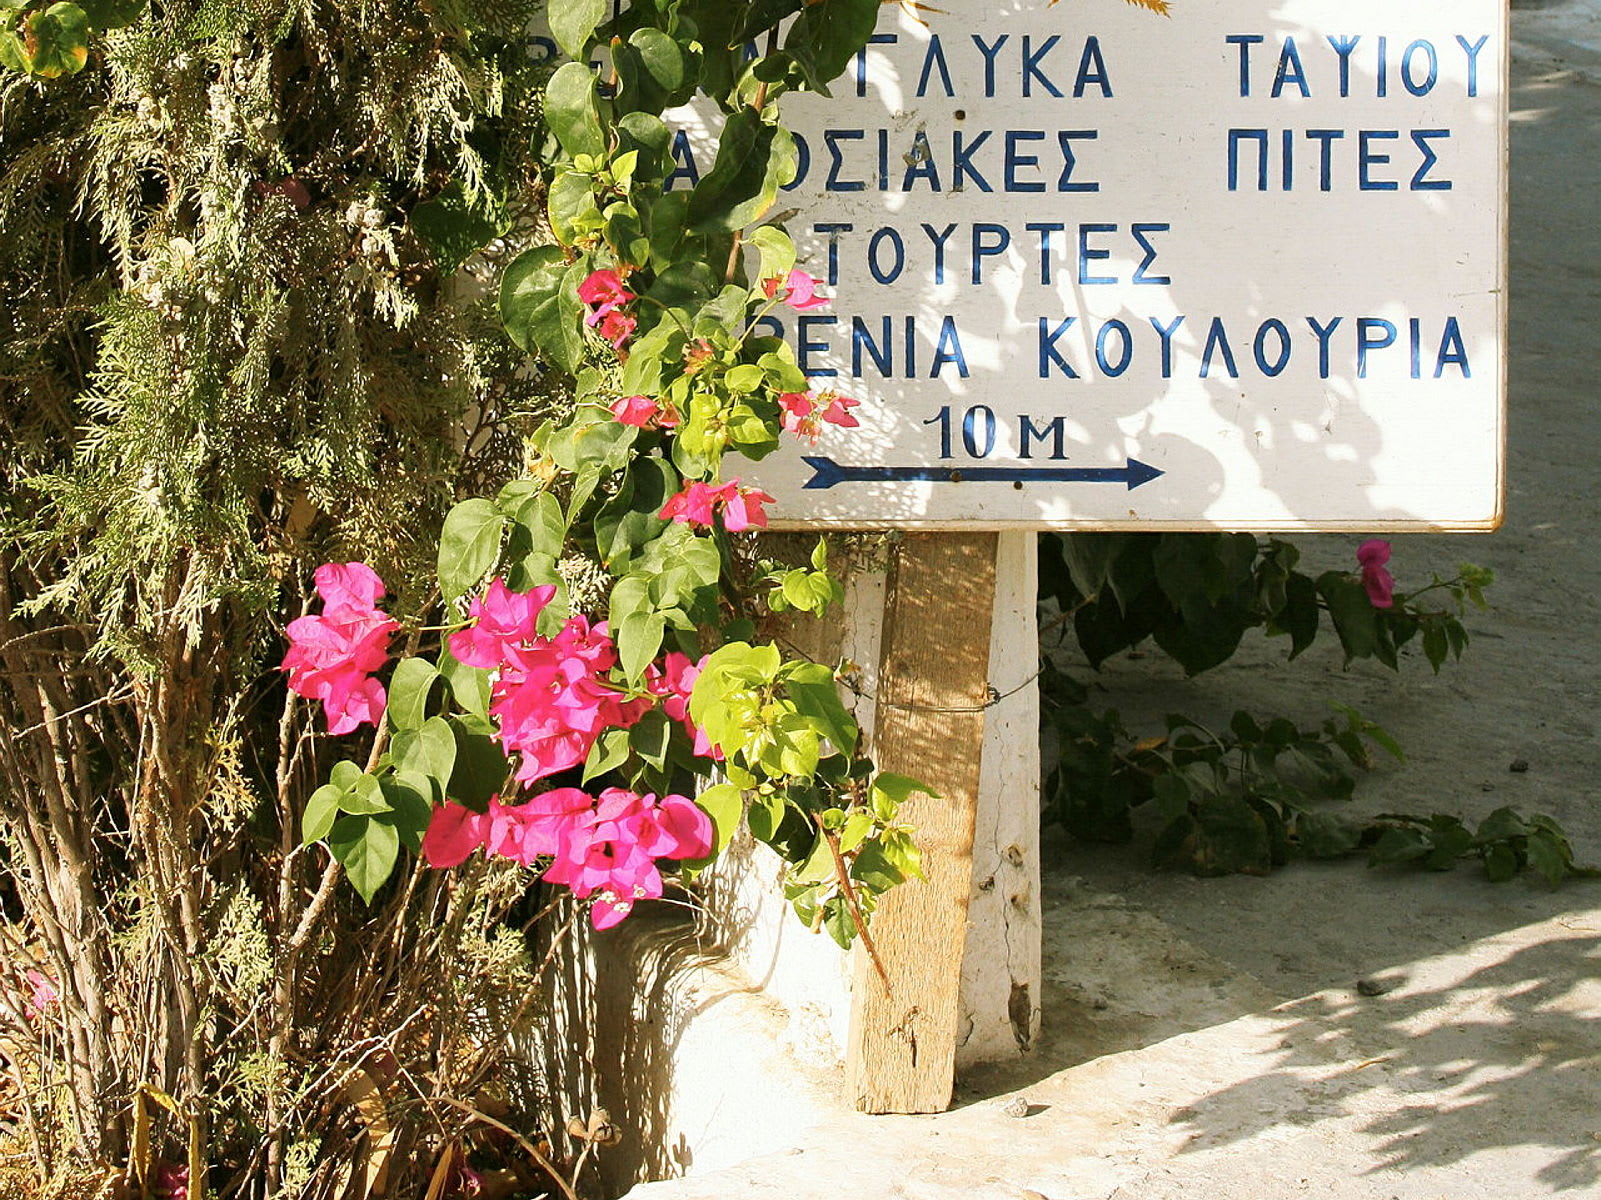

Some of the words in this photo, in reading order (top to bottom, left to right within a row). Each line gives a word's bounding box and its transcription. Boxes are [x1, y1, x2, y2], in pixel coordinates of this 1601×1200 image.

[856, 34, 1113, 98] ΓΛΥΚΑ
[1227, 129, 1453, 191] ΠΙΤΕΣ
[813, 223, 1171, 286] ΤΟΥΡΤΕΣ
[1038, 316, 1472, 379] ΚΟΥΛΟΥΡΙΑ
